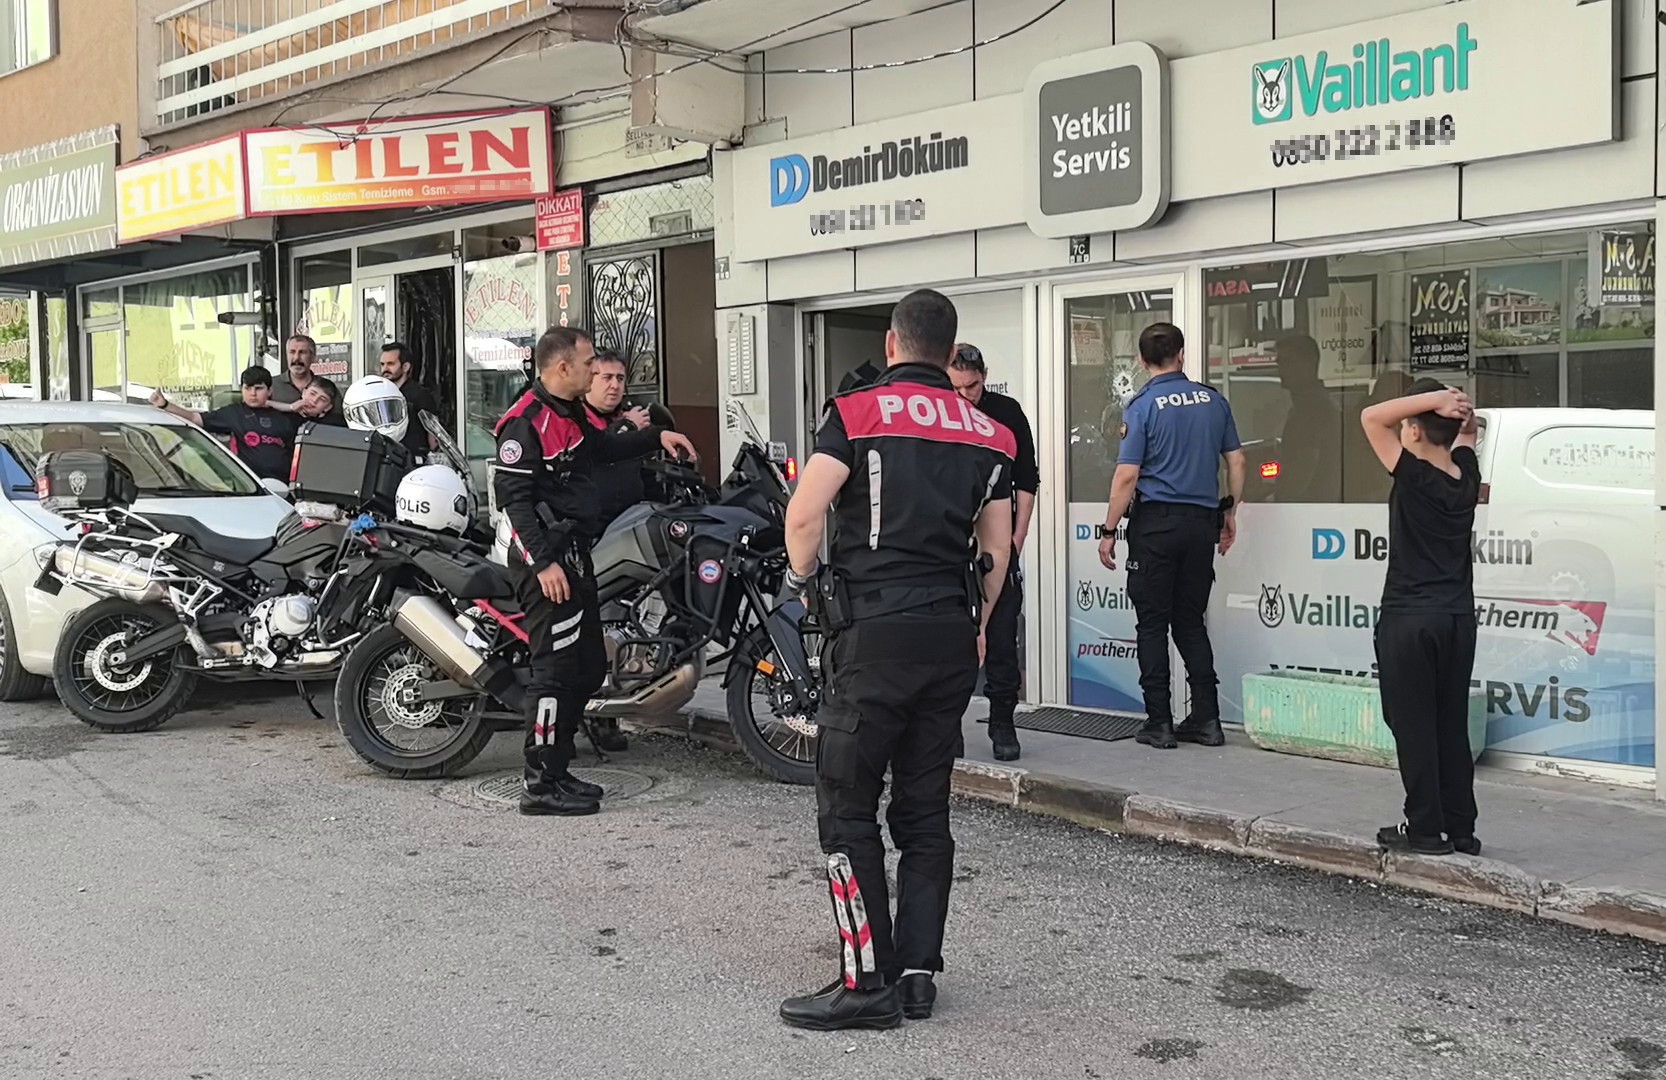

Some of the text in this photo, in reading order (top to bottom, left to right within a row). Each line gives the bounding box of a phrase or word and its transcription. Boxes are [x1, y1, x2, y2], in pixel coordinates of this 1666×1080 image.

[1295, 22, 1478, 117] Vaillant
[1051, 102, 1131, 142] Yetkili
[812, 132, 969, 193] DemirDöküm
[1053, 141, 1131, 178] Servis
[3, 162, 105, 233] ORGANİZASYON
[360, 186, 414, 199] Temizleme
[472, 345, 531, 363] Temizleme
